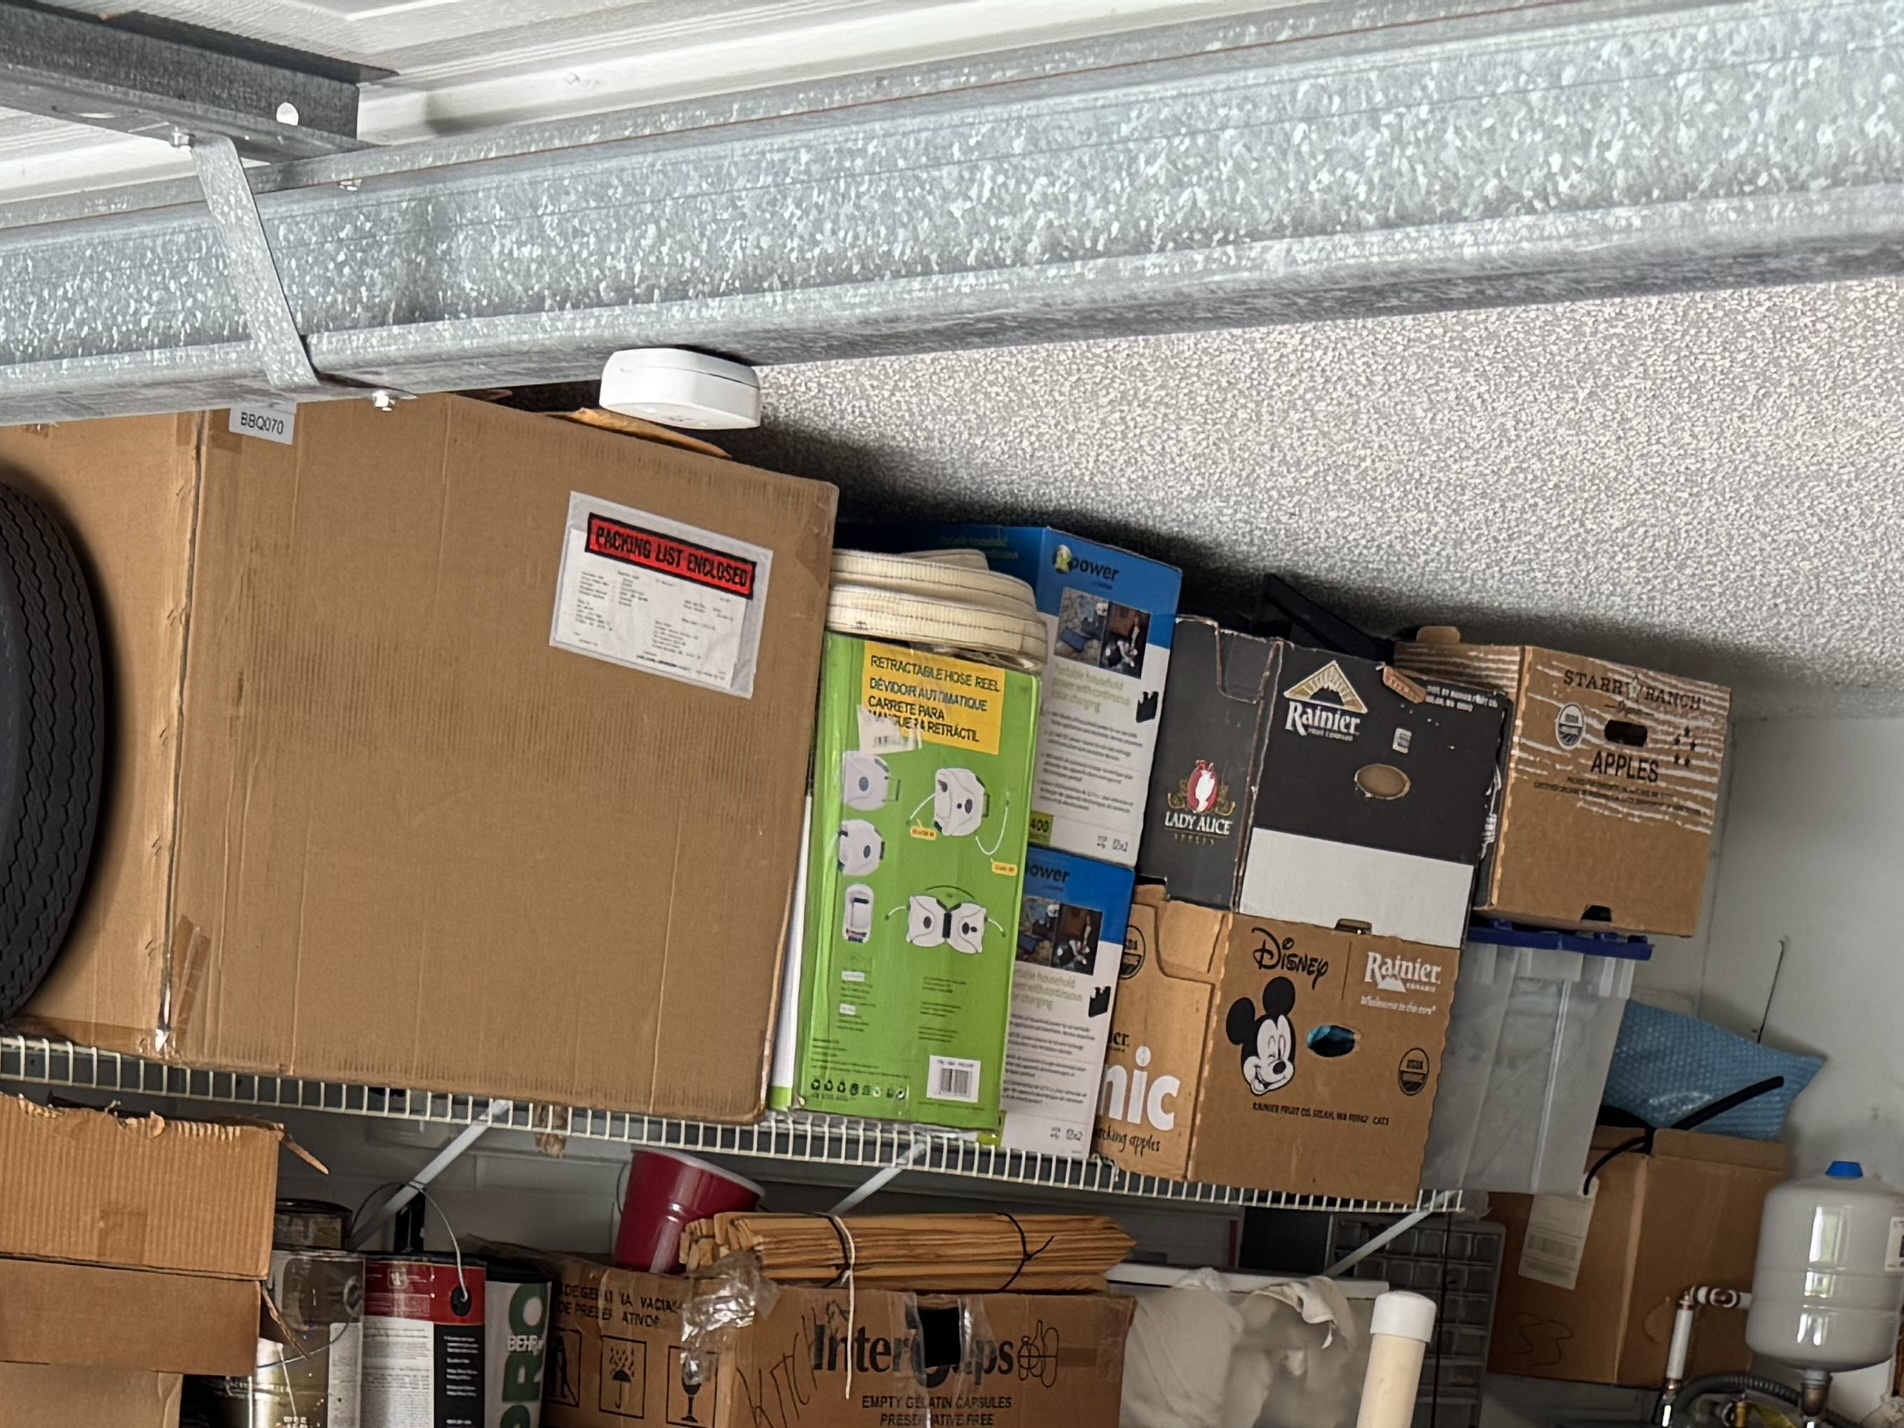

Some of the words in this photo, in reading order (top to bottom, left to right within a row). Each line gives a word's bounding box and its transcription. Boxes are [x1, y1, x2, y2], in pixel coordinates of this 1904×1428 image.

[240, 412, 285, 435] BBQ070
[596, 526, 651, 559] PACKING
[657, 543, 684, 568] LIST
[687, 554, 747, 588] ENCLOSED
[871, 655, 943, 681] RETRACTABLE
[944, 670, 972, 686] HOSE
[975, 676, 1000, 692] REEL
[1563, 669, 1623, 695] STARR
[1645, 687, 1702, 710] RANCH
[868, 695, 916, 715] CARRETE
[918, 702, 945, 721] PARA
[1591, 750, 1659, 782] APPLES
[1165, 811, 1196, 829] LADY
[1196, 816, 1233, 835] ALICE
[1129, 1133, 1161, 1157] apples
[507, 1335, 538, 1352] BEHR
[814, 1322, 1014, 1388] Interaps
[862, 1396, 902, 1409] EMPTY
[905, 1396, 952, 1410] GELATIN
[955, 1396, 1012, 1411] CAPSULES
[880, 1413, 964, 1427] PRESERATIVE
[966, 1414, 994, 1427] FREE
